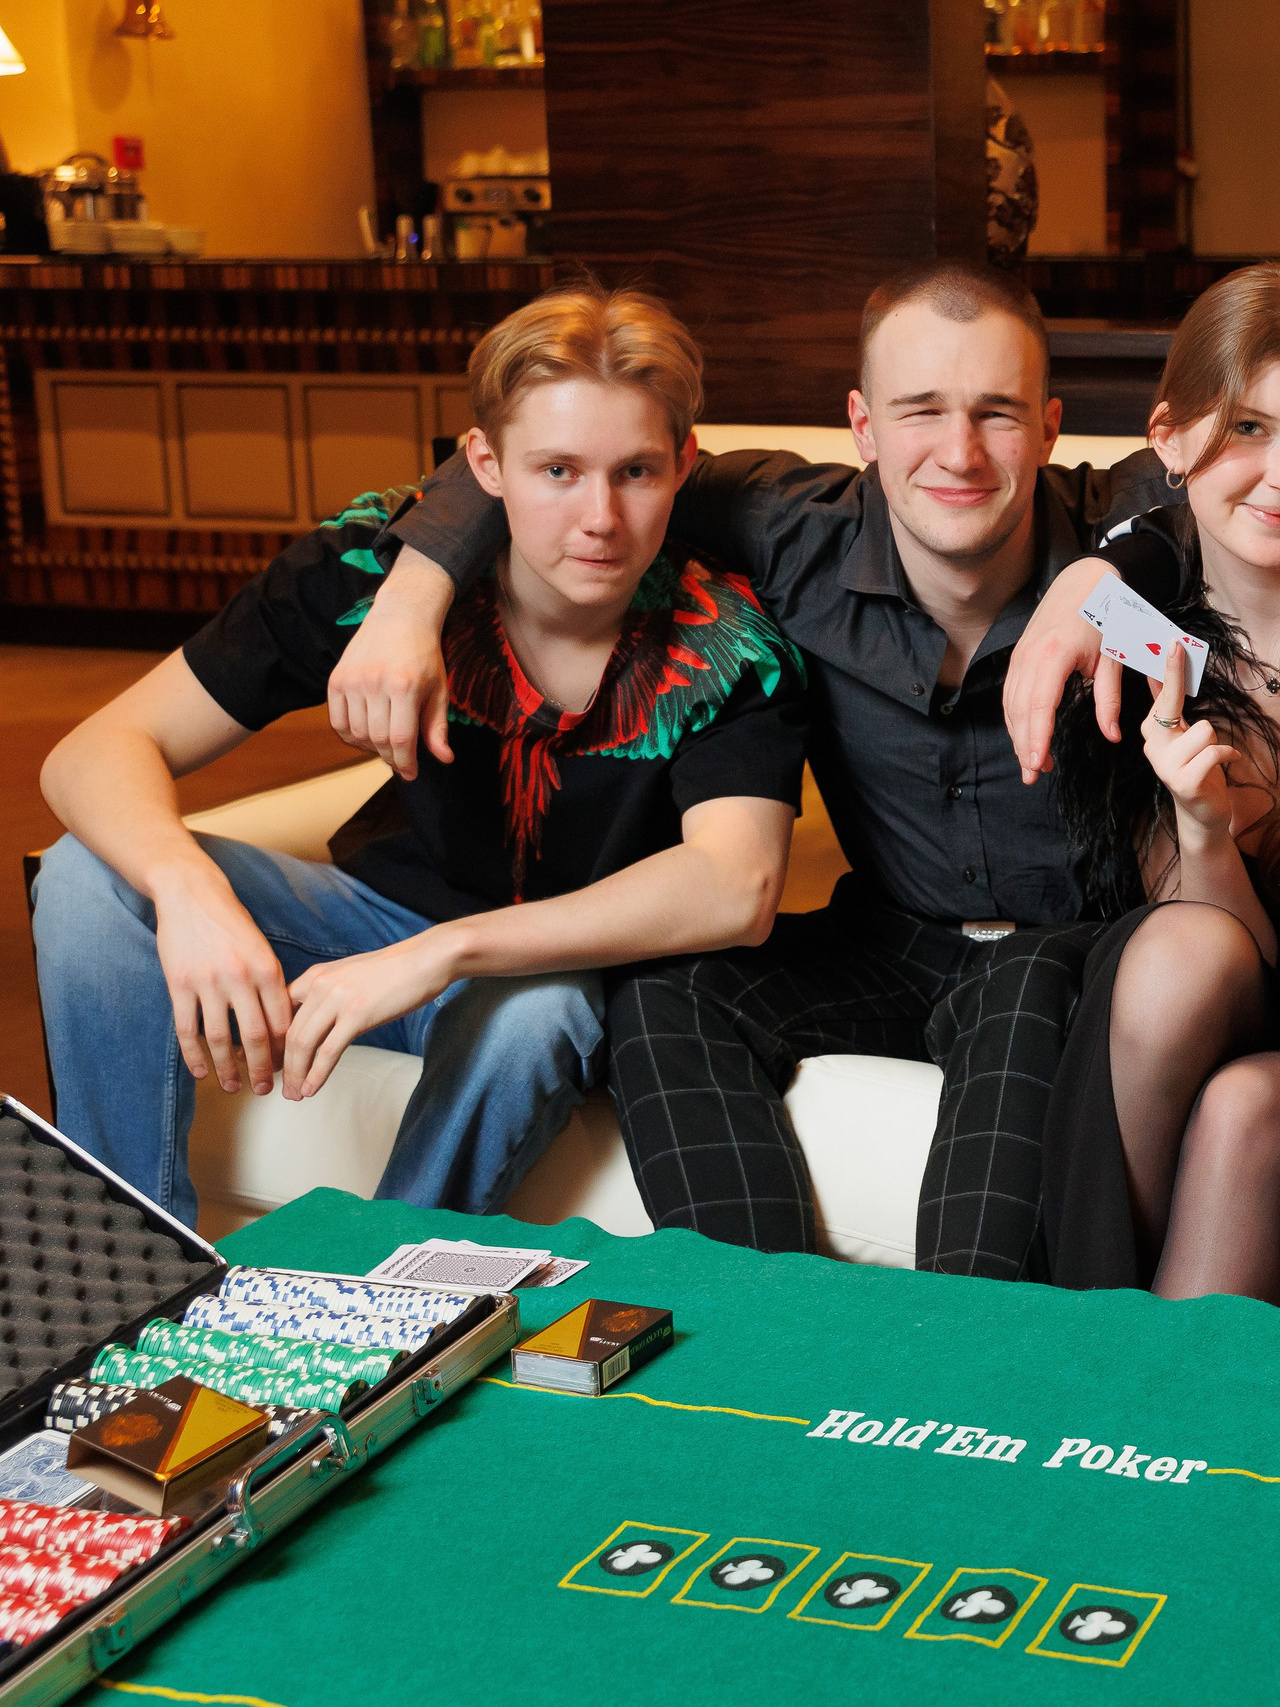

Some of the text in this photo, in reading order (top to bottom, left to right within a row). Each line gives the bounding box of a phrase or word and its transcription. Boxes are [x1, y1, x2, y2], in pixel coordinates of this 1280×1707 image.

[1083, 609, 1096, 621] A
[1191, 639, 1205, 649] A
[1105, 647, 1118, 657] A
[806, 1408, 1208, 1485] Hold'Em Poker
